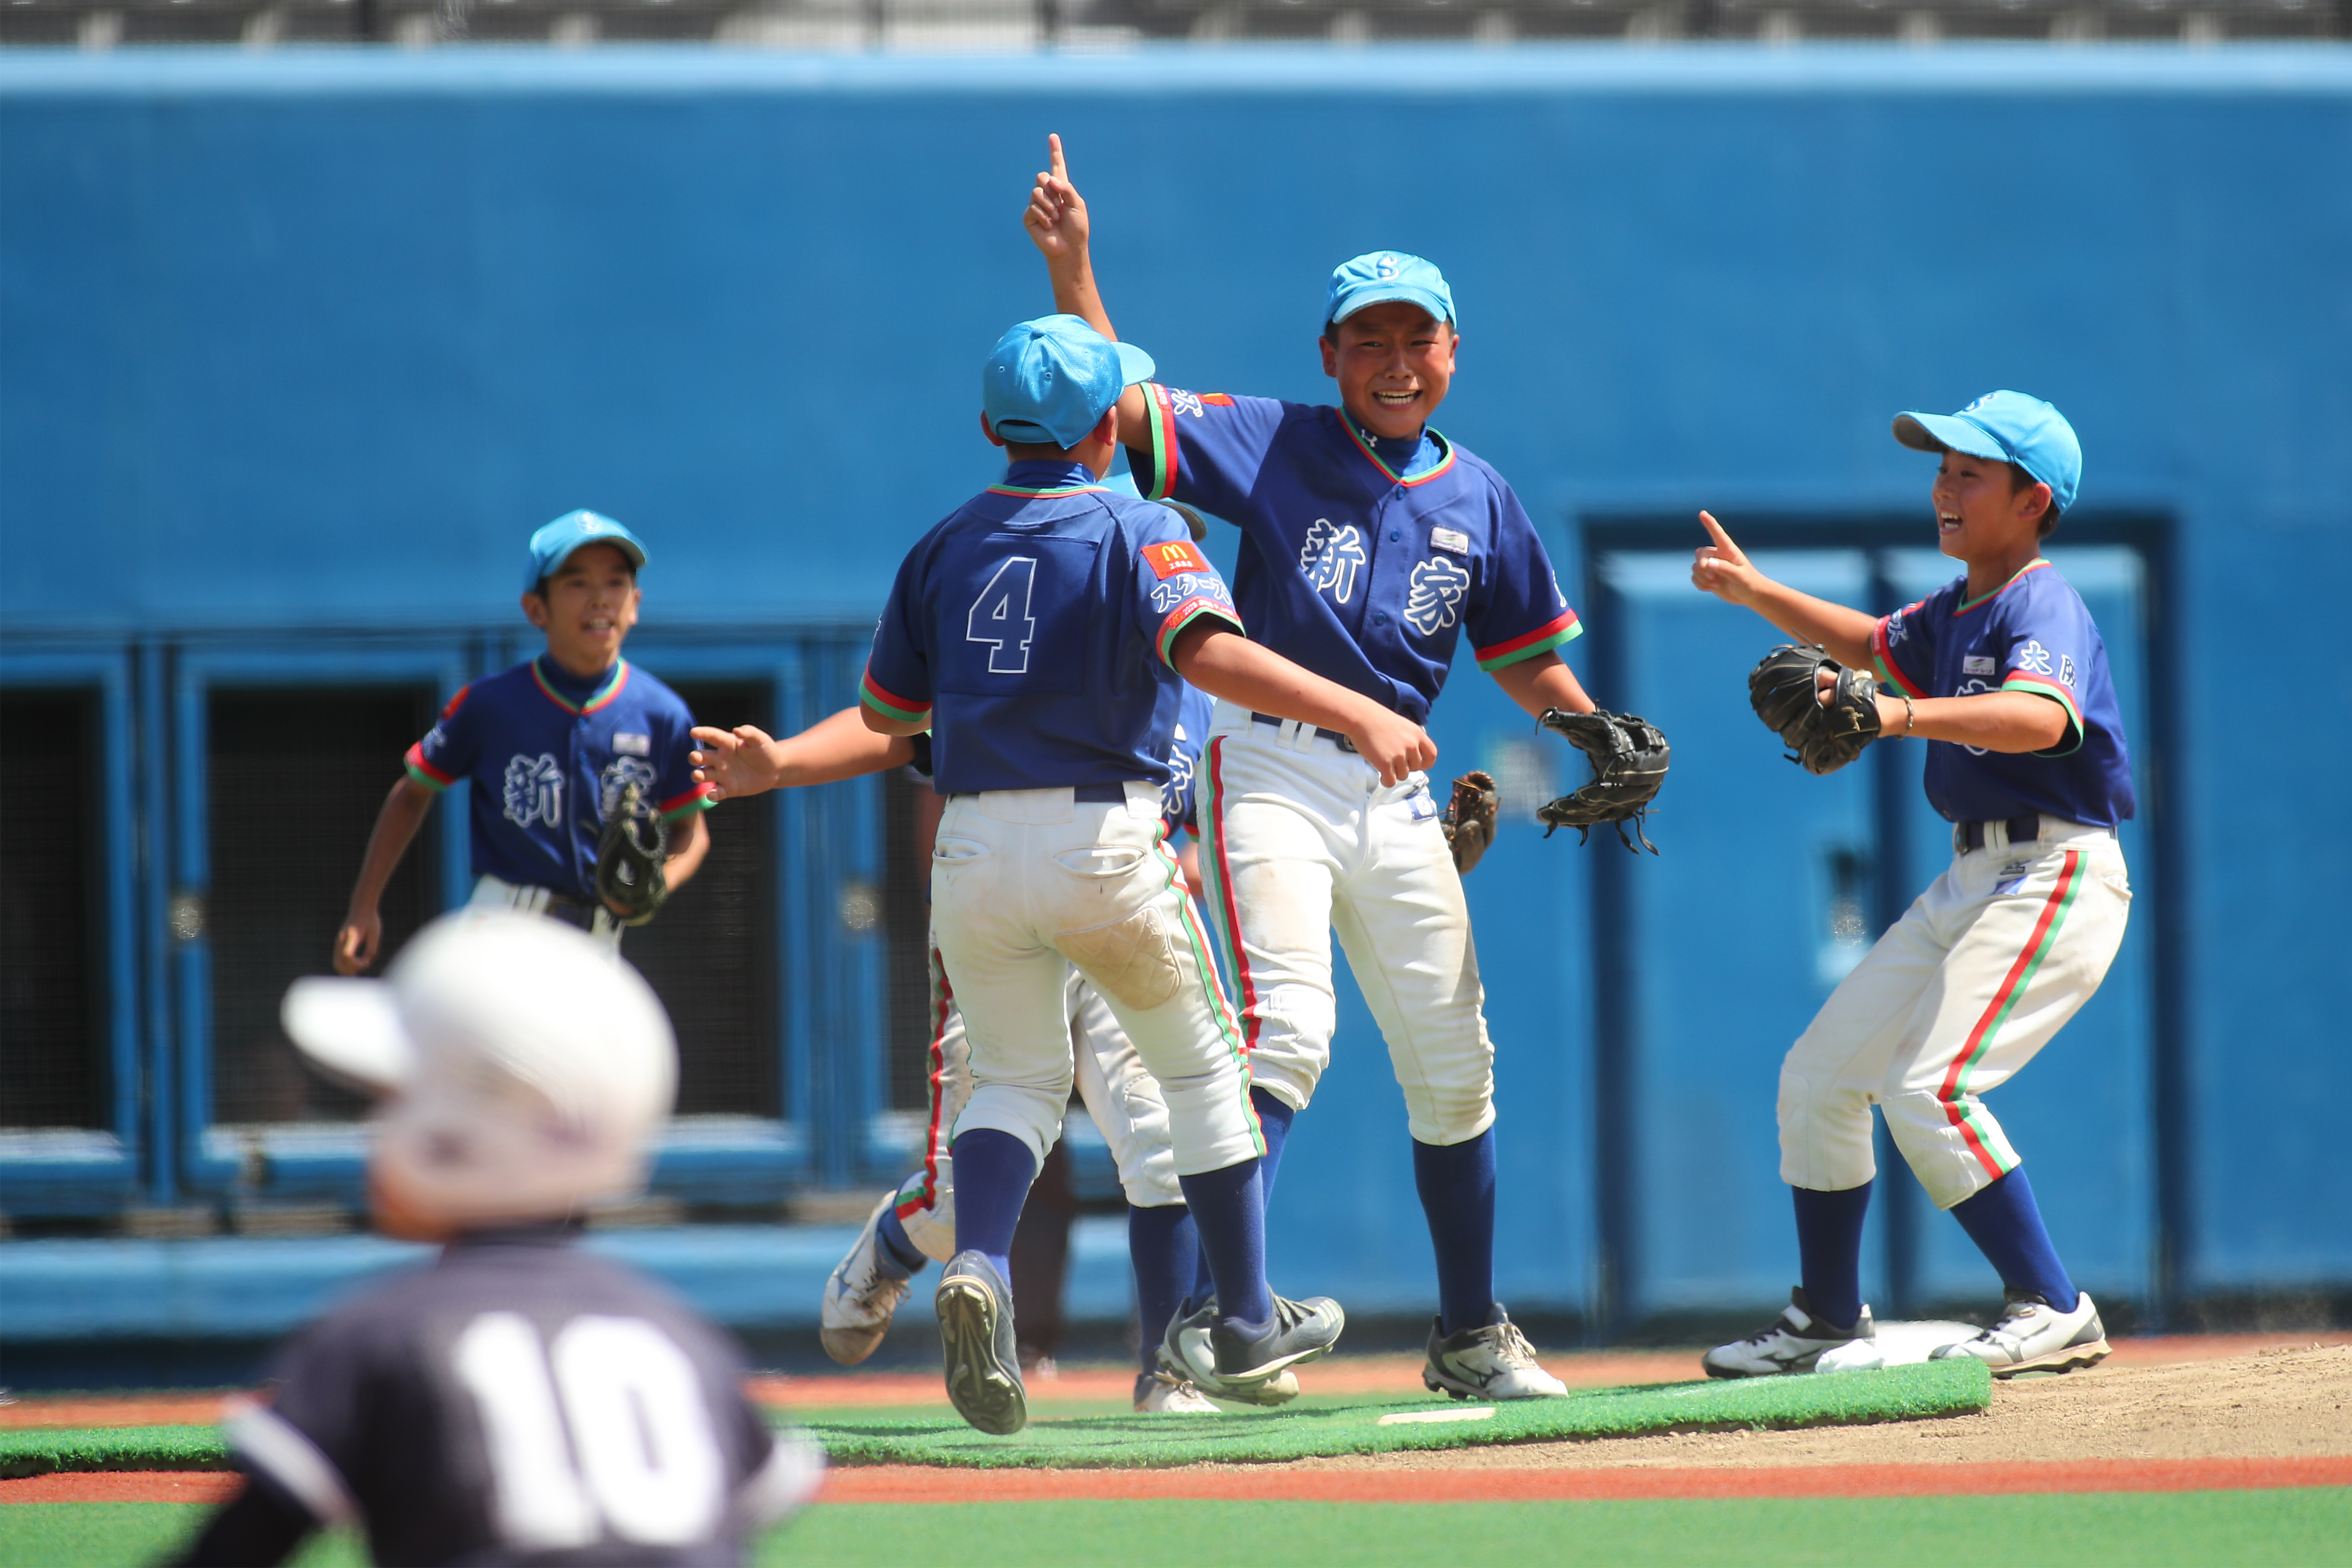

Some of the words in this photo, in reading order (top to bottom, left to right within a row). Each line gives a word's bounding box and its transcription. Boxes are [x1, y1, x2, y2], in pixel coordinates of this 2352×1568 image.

[1376, 254, 1400, 280] S
[966, 556, 1037, 674] 4
[1150, 573, 1231, 614] スターズ
[453, 1311, 727, 1548] 10
